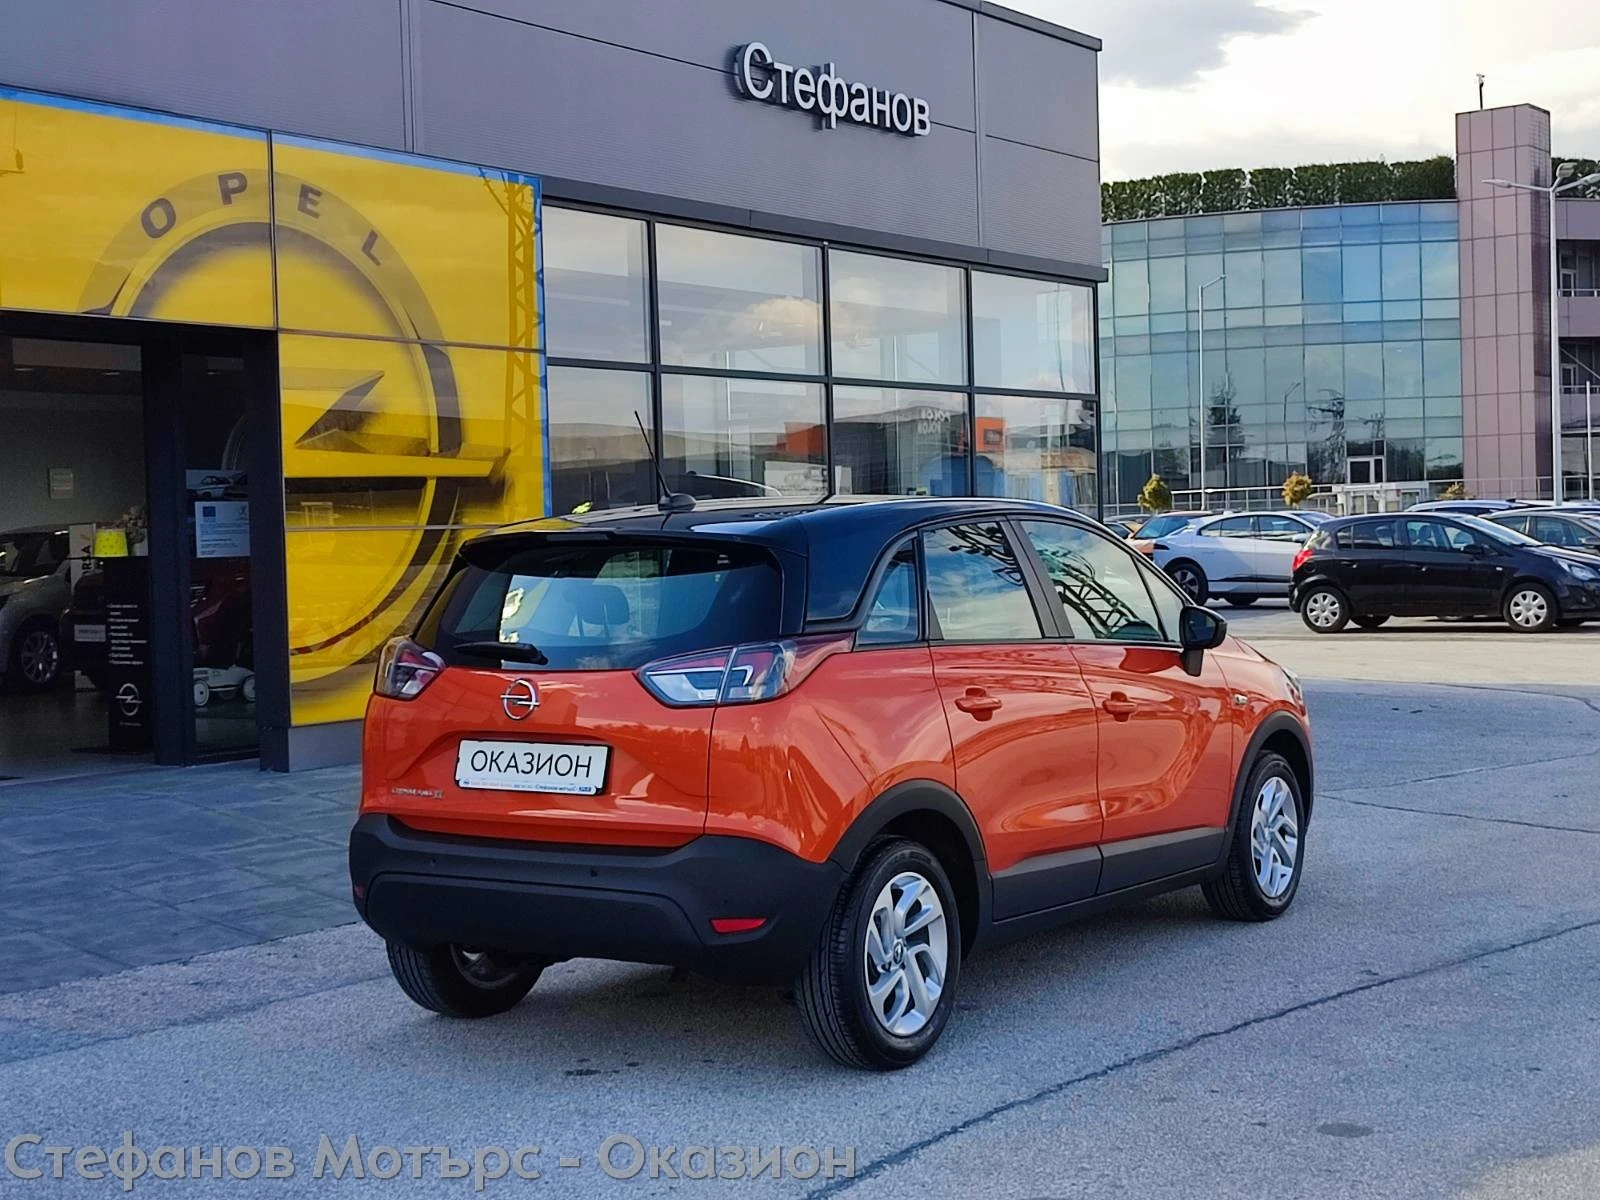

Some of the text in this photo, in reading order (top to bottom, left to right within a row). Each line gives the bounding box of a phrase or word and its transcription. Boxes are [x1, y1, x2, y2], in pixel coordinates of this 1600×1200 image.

[742, 41, 931, 136] Стефанов
[140, 171, 382, 267] OPEL
[470, 750, 592, 778] ОКАЗИОН
